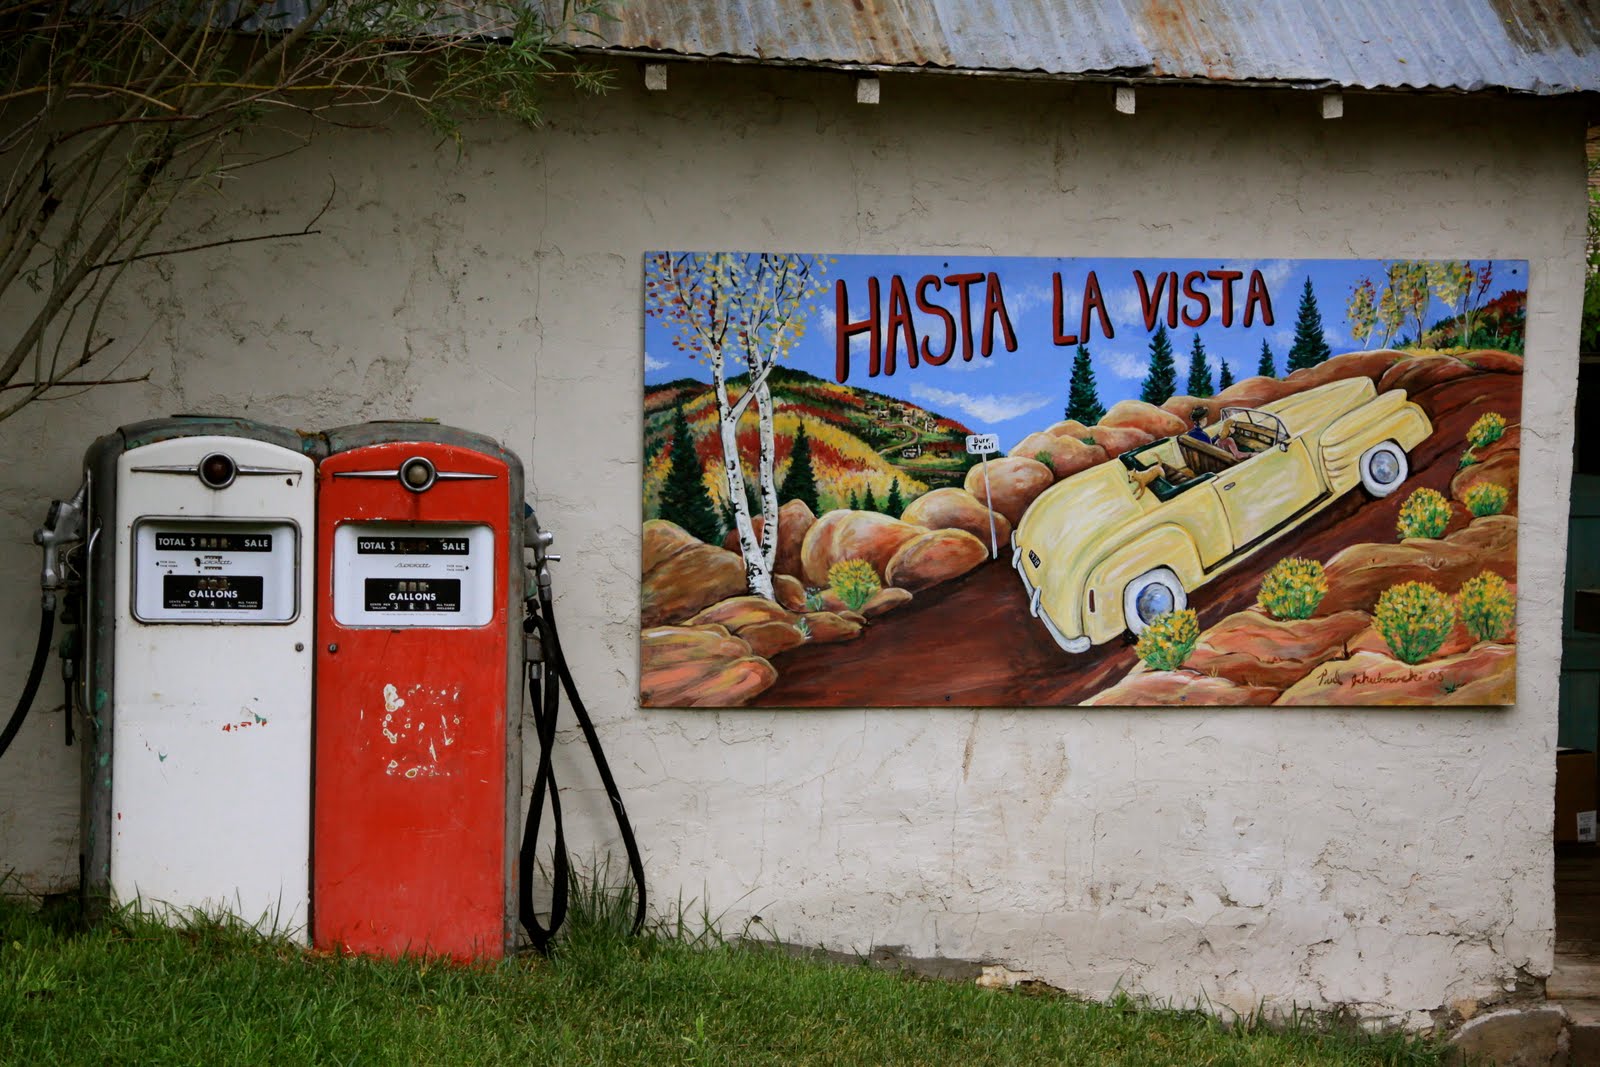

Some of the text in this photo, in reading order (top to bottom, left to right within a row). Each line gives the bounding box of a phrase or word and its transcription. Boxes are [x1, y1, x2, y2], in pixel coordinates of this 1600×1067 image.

[835, 269, 1275, 384] HASTA LA VISTA
[158, 537, 186, 546] TOTAL
[190, 537, 196, 547] $
[244, 539, 268, 548] SALE
[359, 541, 466, 551] TOTAL $ SALE
[188, 590, 238, 598] GALLONS
[388, 592, 436, 601] GALLONS
